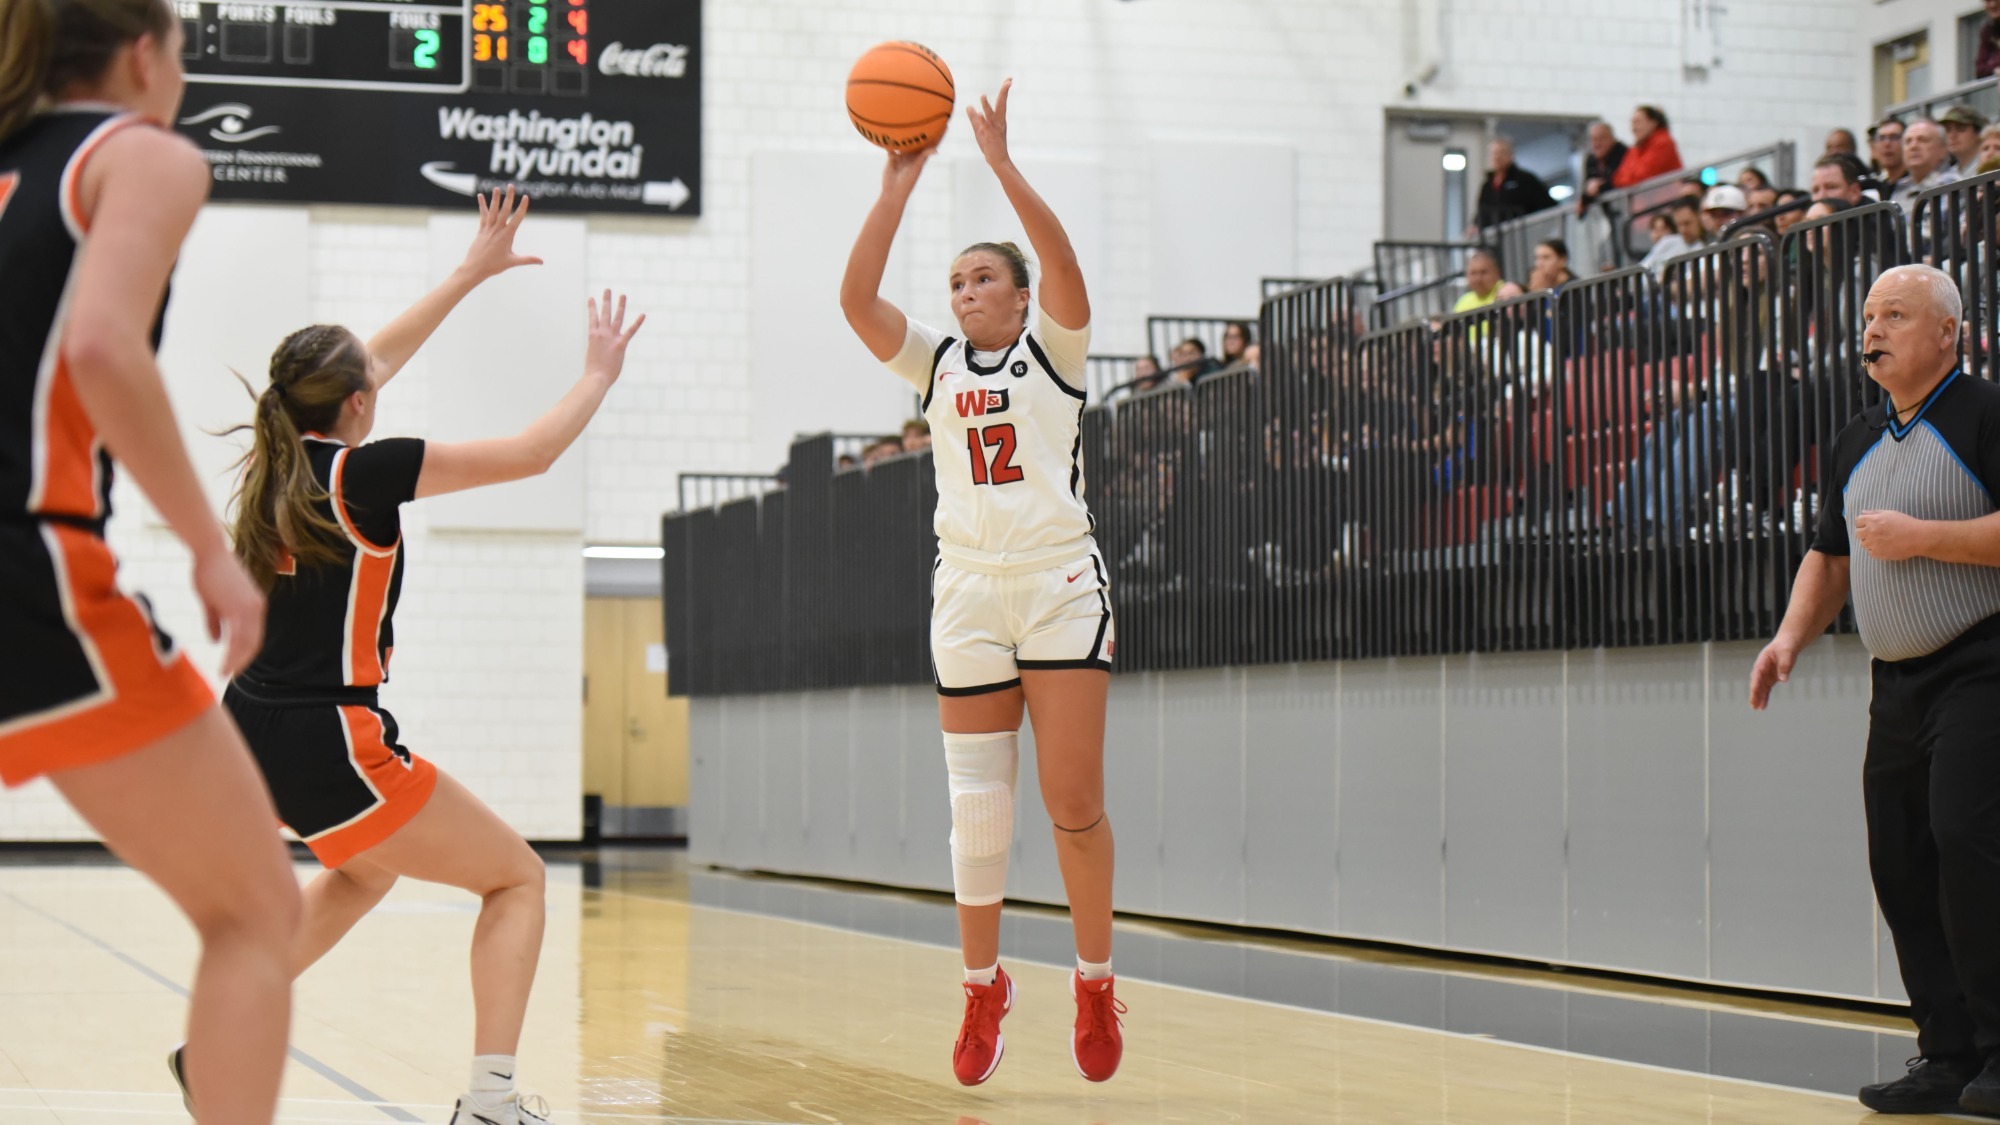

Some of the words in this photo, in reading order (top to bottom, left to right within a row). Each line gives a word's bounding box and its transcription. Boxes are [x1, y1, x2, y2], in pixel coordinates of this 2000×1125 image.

[217, 4, 277, 23] POINTS
[284, 8, 337, 26] FOULS
[389, 12, 441, 30] FOULS
[472, 3, 507, 32] 25
[528, 6, 548, 34] 2
[567, 9, 588, 35] 4
[413, 29, 440, 69] 2
[473, 33, 508, 61] 31
[567, 39, 588, 65] 4
[438, 106, 634, 150] Washington
[489, 139, 644, 181] Hyundai
[955, 387, 1010, 418] W&J
[966, 422, 1025, 486] 12
